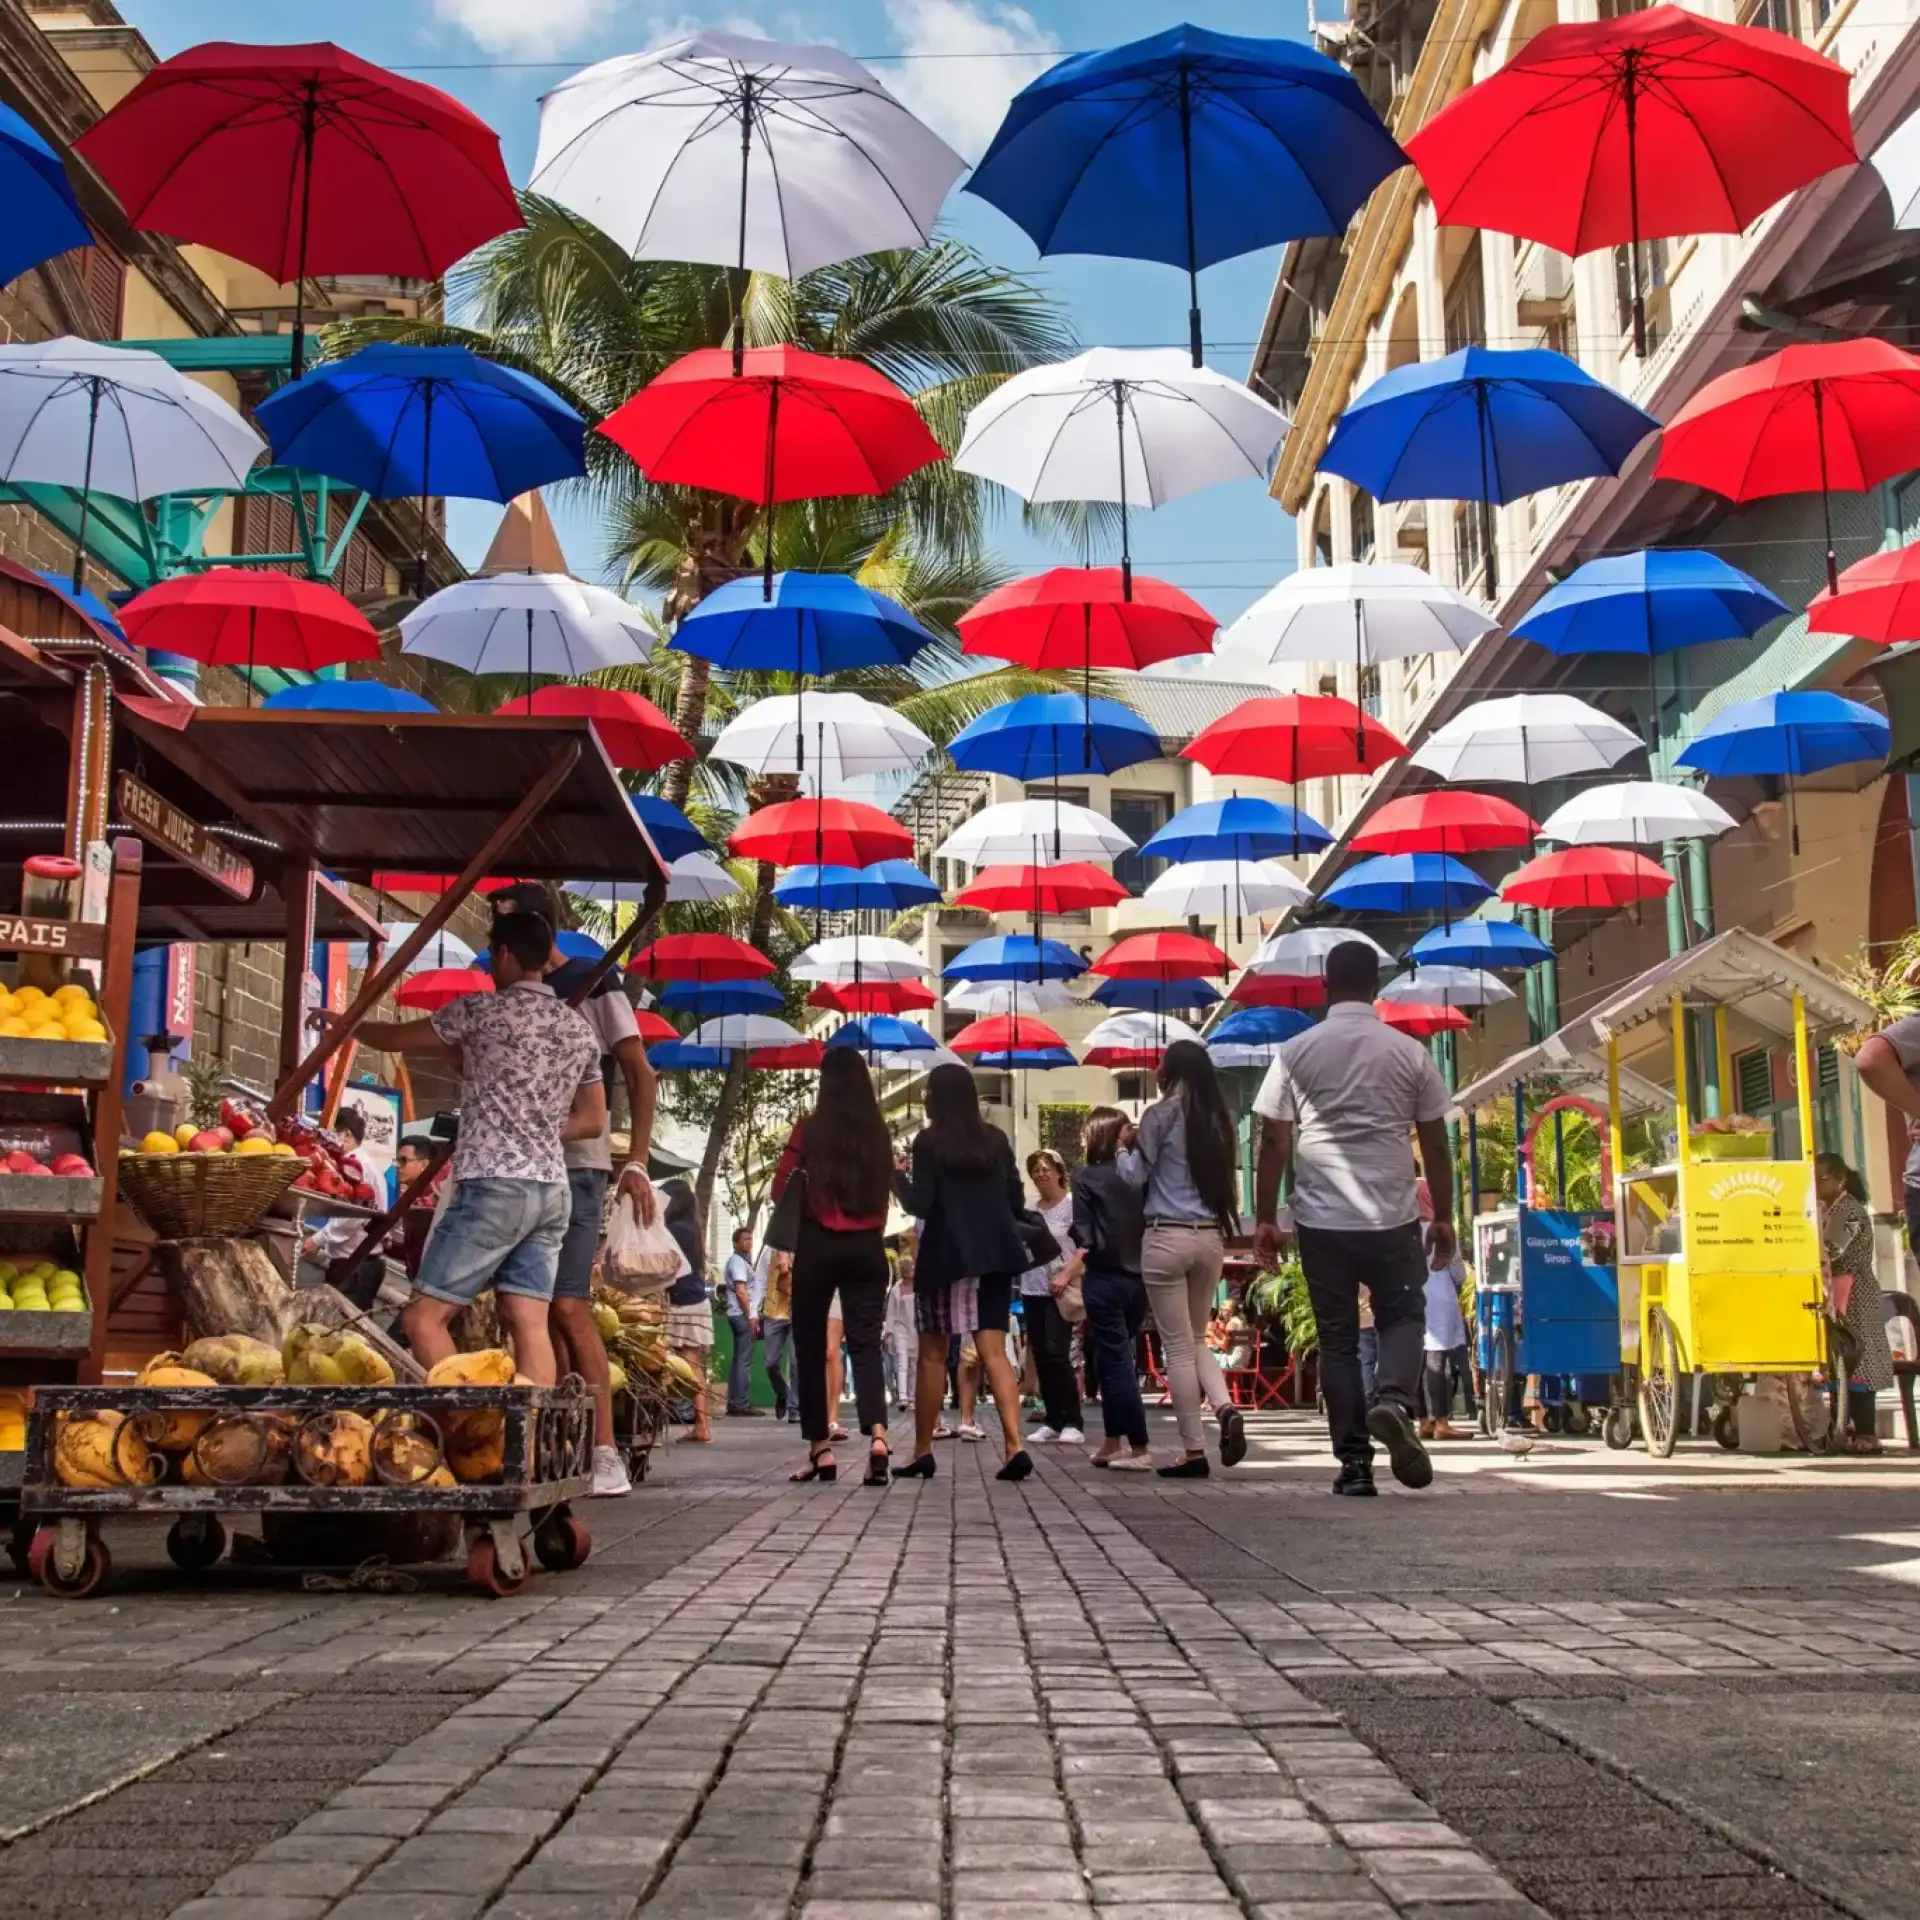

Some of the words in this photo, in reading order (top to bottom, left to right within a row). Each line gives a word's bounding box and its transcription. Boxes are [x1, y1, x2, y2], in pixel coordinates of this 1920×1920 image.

[124, 779, 160, 829] FRESH
[163, 809, 195, 854] JUICE
[201, 839, 222, 873] JUS
[0, 920, 68, 948] RAIS
